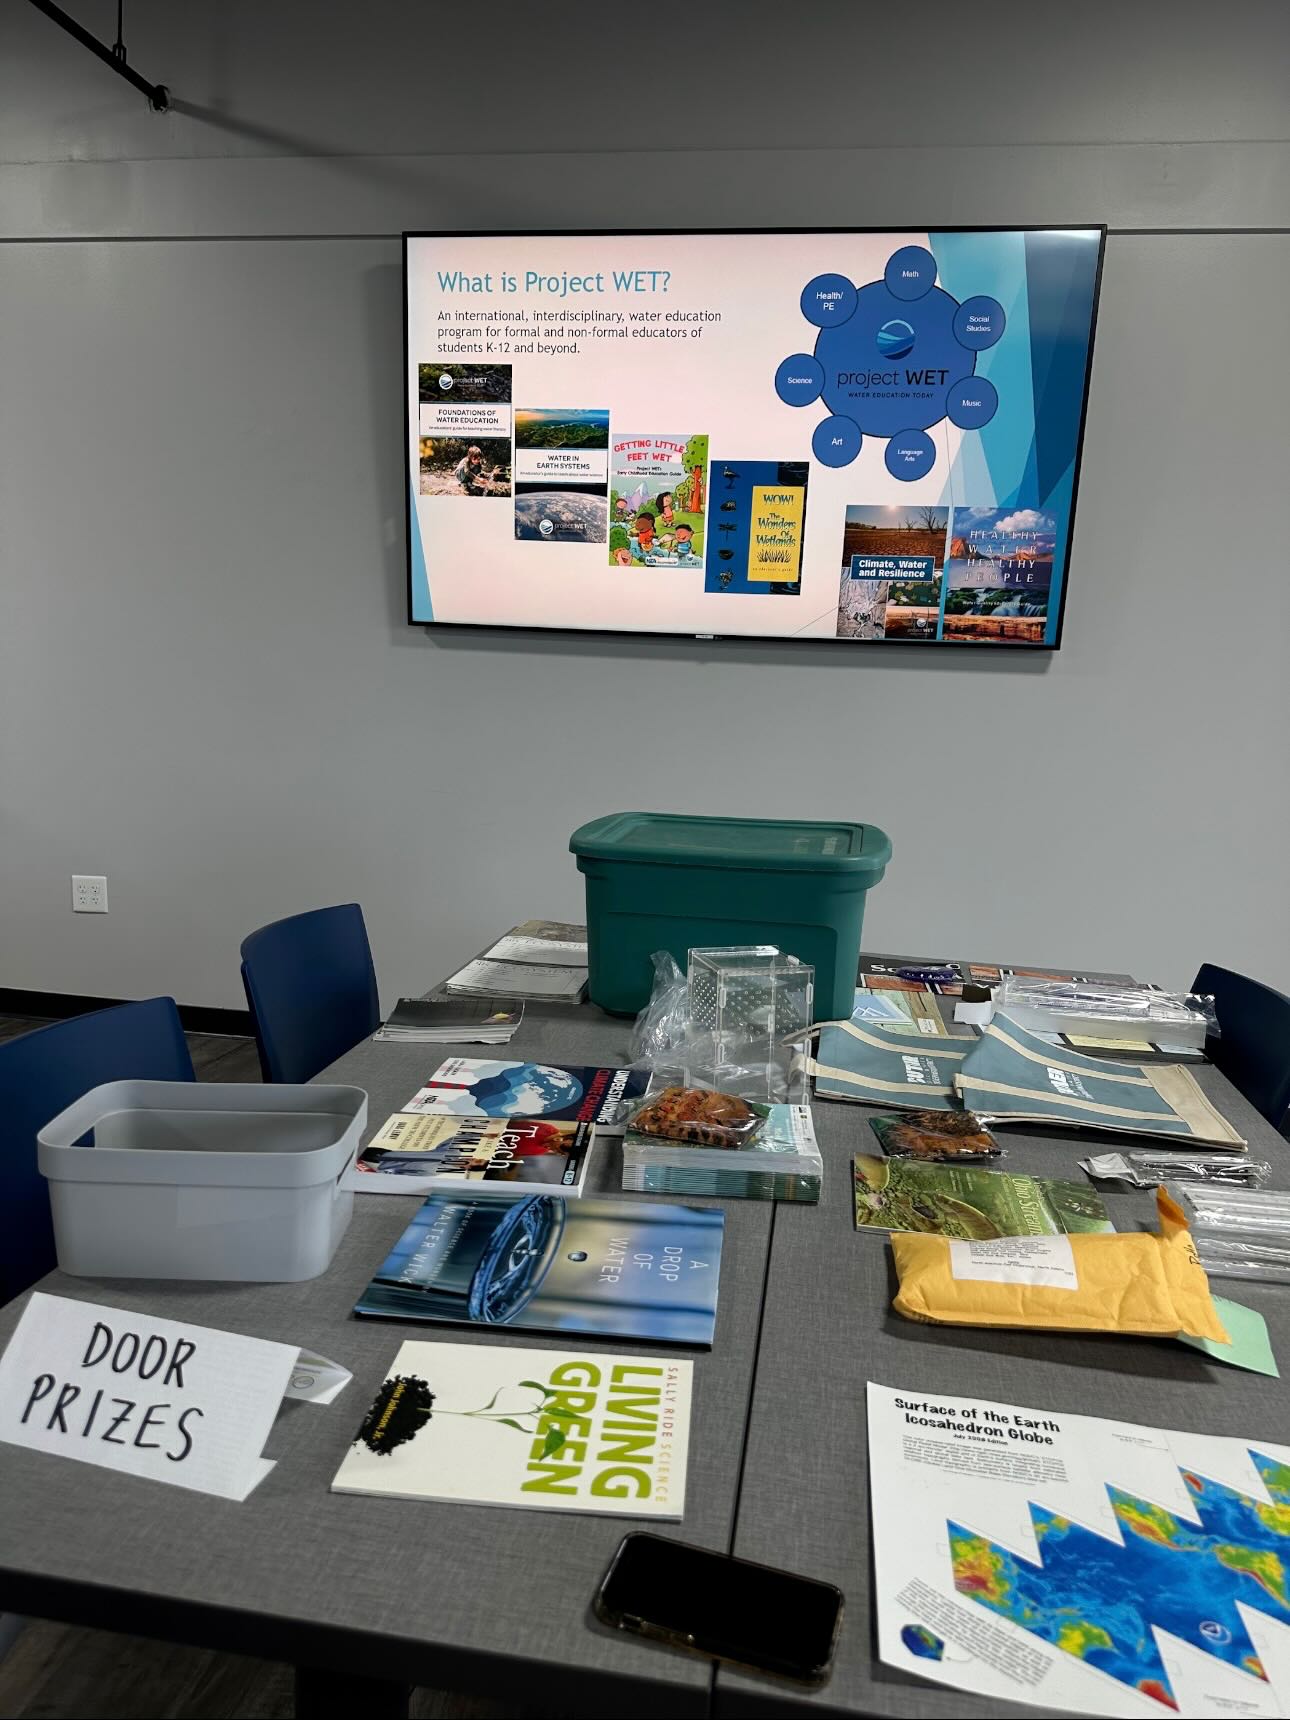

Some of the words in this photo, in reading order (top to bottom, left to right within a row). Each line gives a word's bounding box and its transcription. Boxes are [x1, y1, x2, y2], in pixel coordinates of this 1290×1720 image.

[902, 270, 919, 278] Math
[437, 271, 493, 293] What
[502, 271, 517, 293] is
[525, 271, 604, 297] Project
[613, 271, 671, 293] WET?
[816, 291, 843, 300] Health/
[823, 302, 835, 311] PE
[437, 310, 451, 322] An
[455, 310, 529, 323] international,
[533, 310, 625, 324] interdisciplinary,
[629, 311, 660, 322] water
[665, 310, 722, 322] education
[437, 327, 482, 340] program
[486, 326, 500, 337] for
[505, 326, 540, 337] formal
[544, 326, 564, 338] and
[568, 326, 628, 338] non-formal
[632, 326, 687, 338] educators
[691, 327, 703, 338] of
[437, 342, 483, 353] students
[486, 342, 510, 353] K-12
[514, 342, 534, 353] and
[537, 342, 580, 355] beyond.
[837, 369, 900, 388] project
[905, 369, 949, 386] WET
[962, 399, 982, 407] Music
[613, 439, 651, 452] GETTING
[655, 440, 685, 454] LITTLE
[831, 437, 843, 446] Art
[627, 452, 648, 461] FEET
[652, 453, 672, 462] WET
[763, 494, 794, 503] WOW!
[757, 518, 797, 529] Wonders
[756, 535, 796, 546] Wetlands
[970, 530, 1039, 540] HEALTHY
[968, 544, 1037, 554] WATER
[858, 559, 897, 569] Climate,
[898, 560, 927, 569] Water
[858, 568, 876, 577] and
[878, 569, 925, 578] Resilience
[967, 558, 1036, 569] HEALTHY
[964, 573, 1034, 583] PEOPLE
[588, 1069, 610, 1096] CLIMATE
[597, 1070, 631, 1122] UNDERSTANDING
[576, 1095, 601, 1122] CHANGE
[436, 1118, 491, 1174] CHAMPION
[487, 1126, 538, 1169] Teach
[1012, 1178, 1032, 1199] Ohio
[421, 1205, 457, 1247] WALTER
[398, 1253, 428, 1284] WICK
[599, 1237, 630, 1284] WATER
[633, 1252, 652, 1271] OF
[660, 1246, 683, 1281] DROP
[689, 1259, 708, 1270] A
[81, 1322, 196, 1388] DOOR
[392, 1382, 407, 1398] John
[664, 1367, 679, 1404] SALLY
[21, 1373, 204, 1461] PRIZES
[662, 1406, 674, 1438] RIDE
[894, 1397, 956, 1416] Surface
[961, 1408, 978, 1419] of
[983, 1410, 1009, 1424] the
[1014, 1415, 1061, 1433] Earth
[520, 1361, 602, 1495] GREEN
[590, 1364, 664, 1499] LIVING
[905, 1413, 1004, 1437] Icosahedron
[1008, 1428, 1054, 1446] Globe
[655, 1443, 673, 1504] SCIENCE
